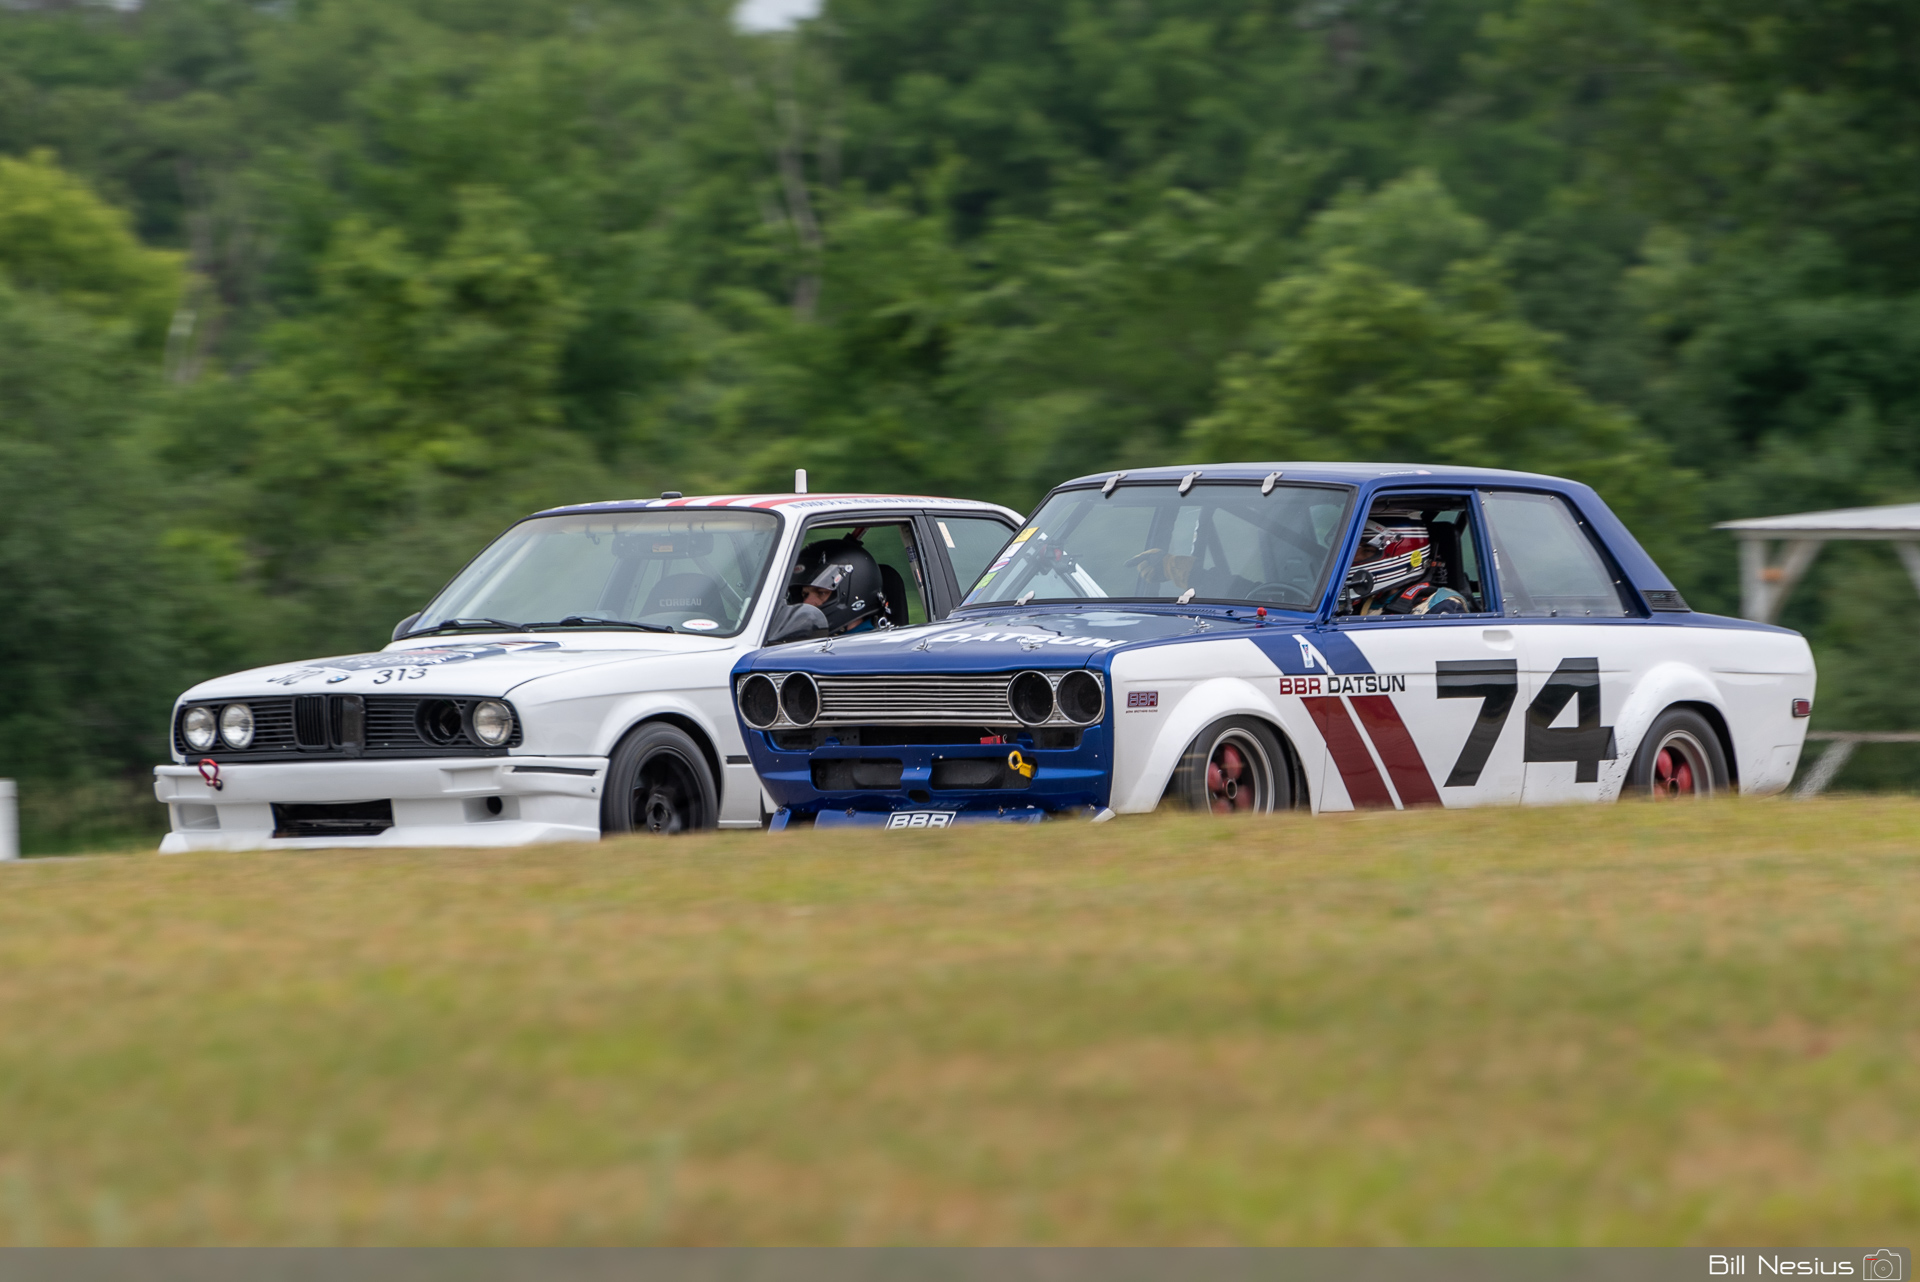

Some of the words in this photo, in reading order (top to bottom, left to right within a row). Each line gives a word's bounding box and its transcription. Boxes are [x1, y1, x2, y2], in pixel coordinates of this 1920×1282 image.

[659, 598, 702, 607] CORBEAU
[927, 632, 1129, 648] DATSUN
[373, 667, 428, 685] 313
[1279, 677, 1321, 695] BBR
[1327, 675, 1405, 694] DATSUN
[1129, 693, 1157, 706] BBR
[1435, 657, 1618, 788] 74
[889, 814, 949, 828] BBR
